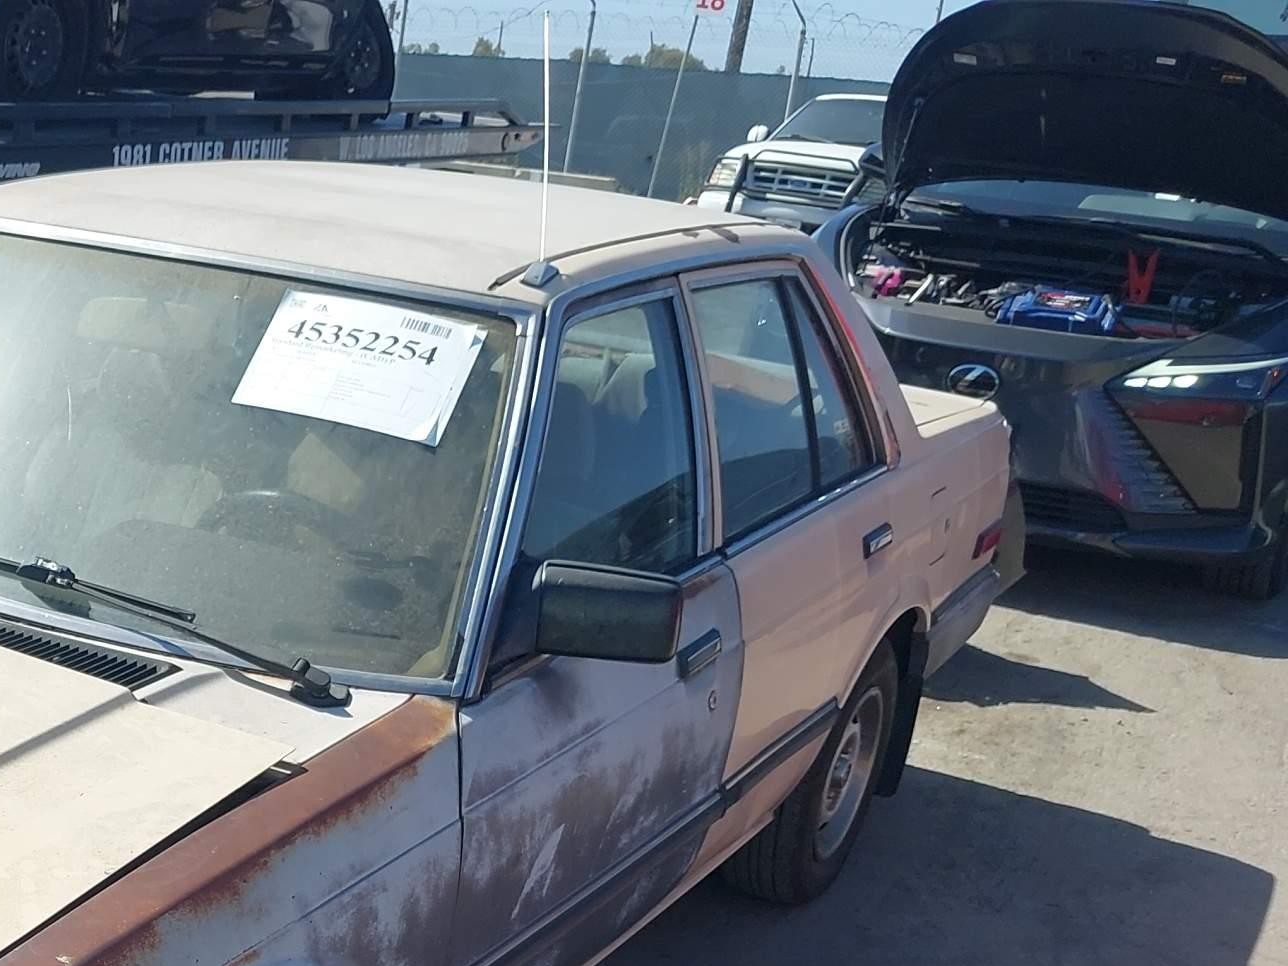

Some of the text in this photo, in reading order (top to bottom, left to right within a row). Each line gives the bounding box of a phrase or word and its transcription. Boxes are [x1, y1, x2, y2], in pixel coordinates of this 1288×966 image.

[112, 137, 290, 167] 1981 COTNER AVENUE
[287, 319, 439, 367] 45352254
